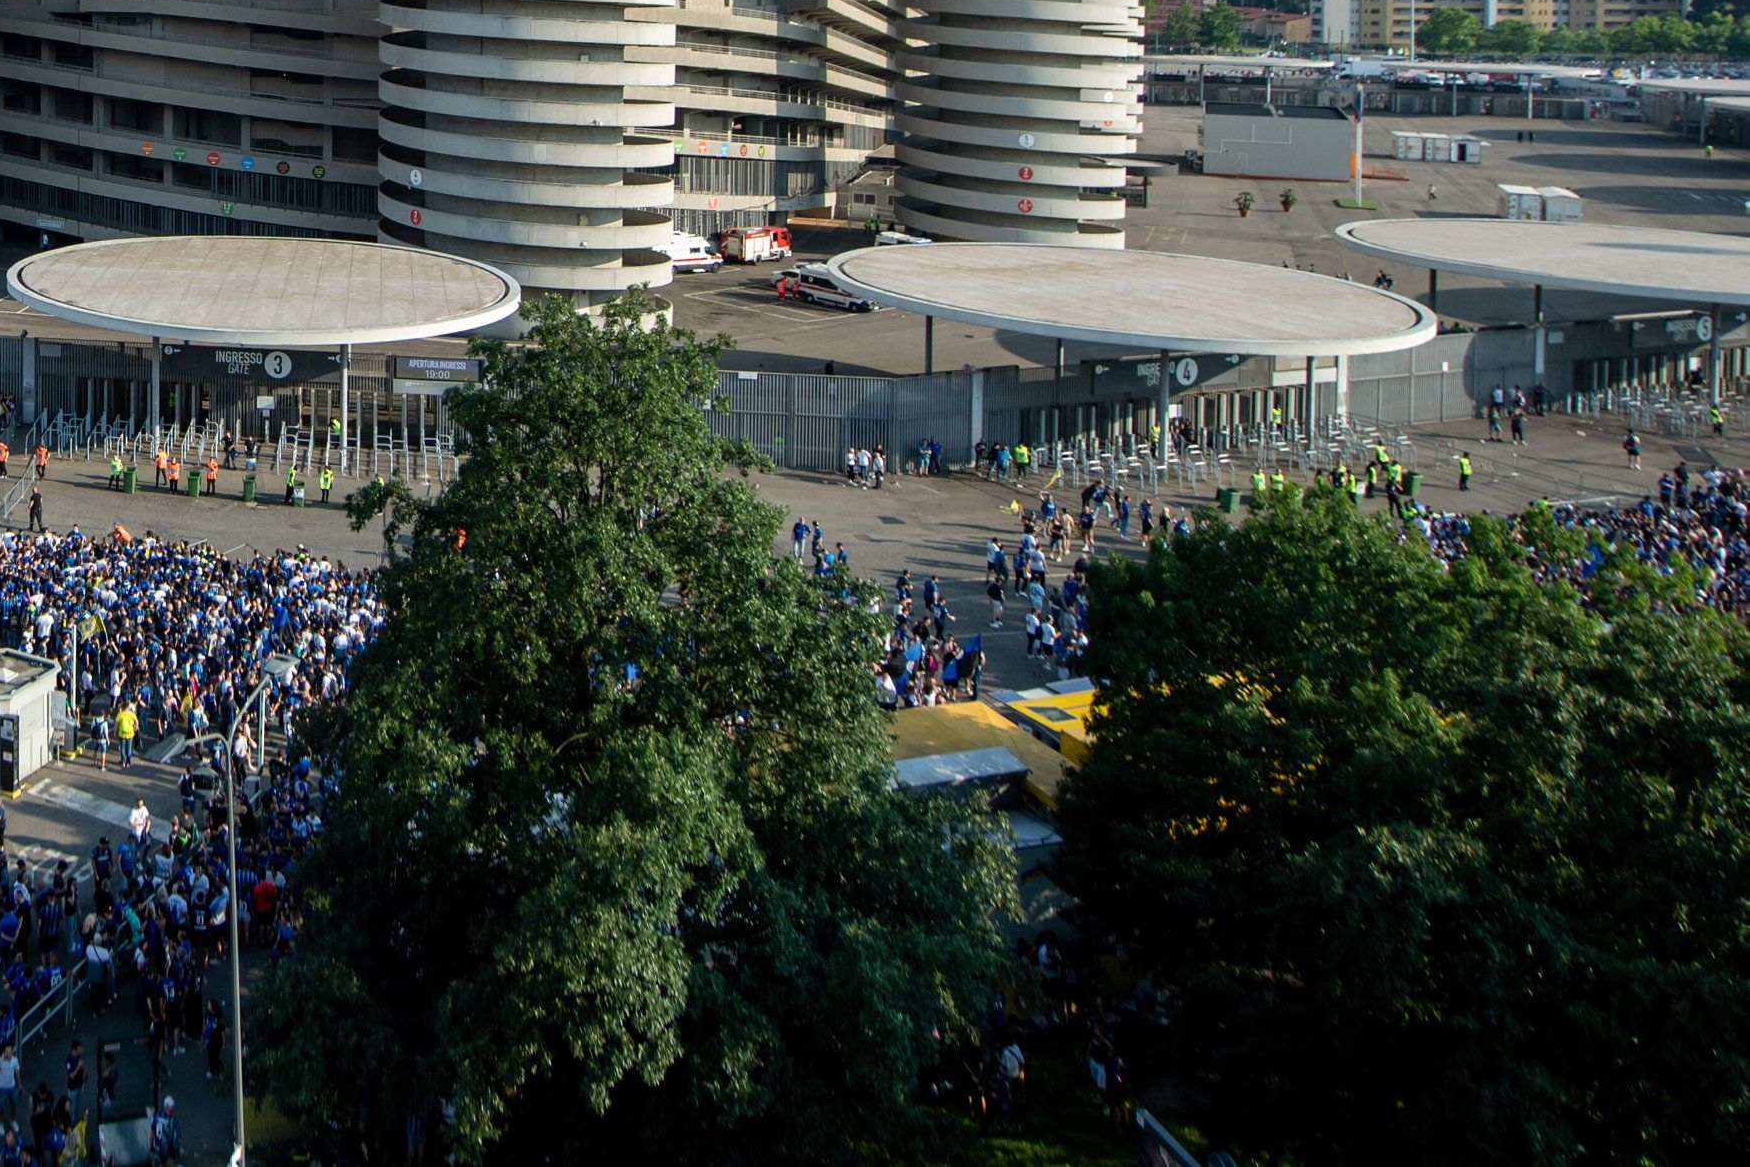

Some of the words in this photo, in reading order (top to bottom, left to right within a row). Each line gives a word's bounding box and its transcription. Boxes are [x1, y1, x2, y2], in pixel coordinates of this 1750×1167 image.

[215, 350, 263, 365] INGRESSO
[273, 355, 282, 375] 3
[409, 359, 439, 369] APERTURA
[439, 360, 466, 370] INGRESSI
[227, 363, 250, 375] GATE
[425, 370, 451, 379] 19:00
[1137, 362, 1175, 376] INGREO
[1182, 361, 1191, 382] 4
